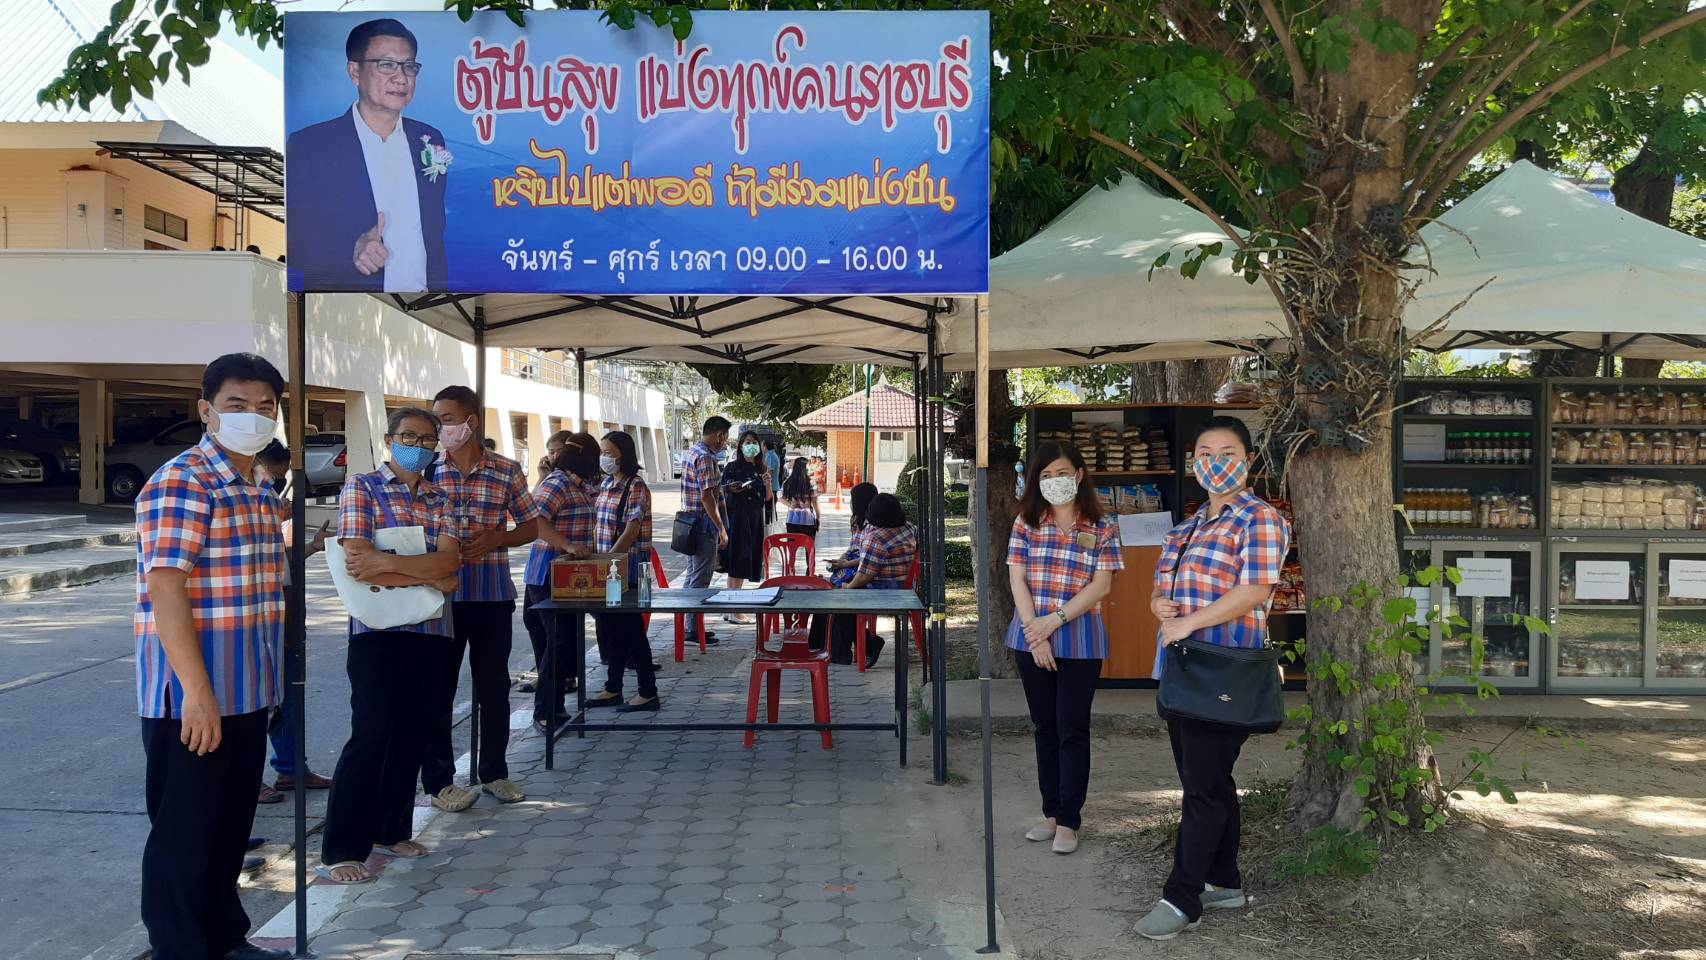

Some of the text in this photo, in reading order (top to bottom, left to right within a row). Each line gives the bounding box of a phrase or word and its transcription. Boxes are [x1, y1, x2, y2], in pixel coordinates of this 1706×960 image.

[456, 24, 970, 152] ตู้ปันสุข แบ่งทุกข์คนราชบุรี
[493, 138, 956, 218] หยิบไปแต่พอดี ถ้ามีร่วมแบ่งปัน
[501, 238, 575, 272] จันทร์
[608, 238, 662, 284] ศุกร์
[670, 249, 727, 272] เวลา
[736, 246, 807, 272] 09.00
[842, 245, 908, 272] 16.00
[917, 249, 943, 271] น.
